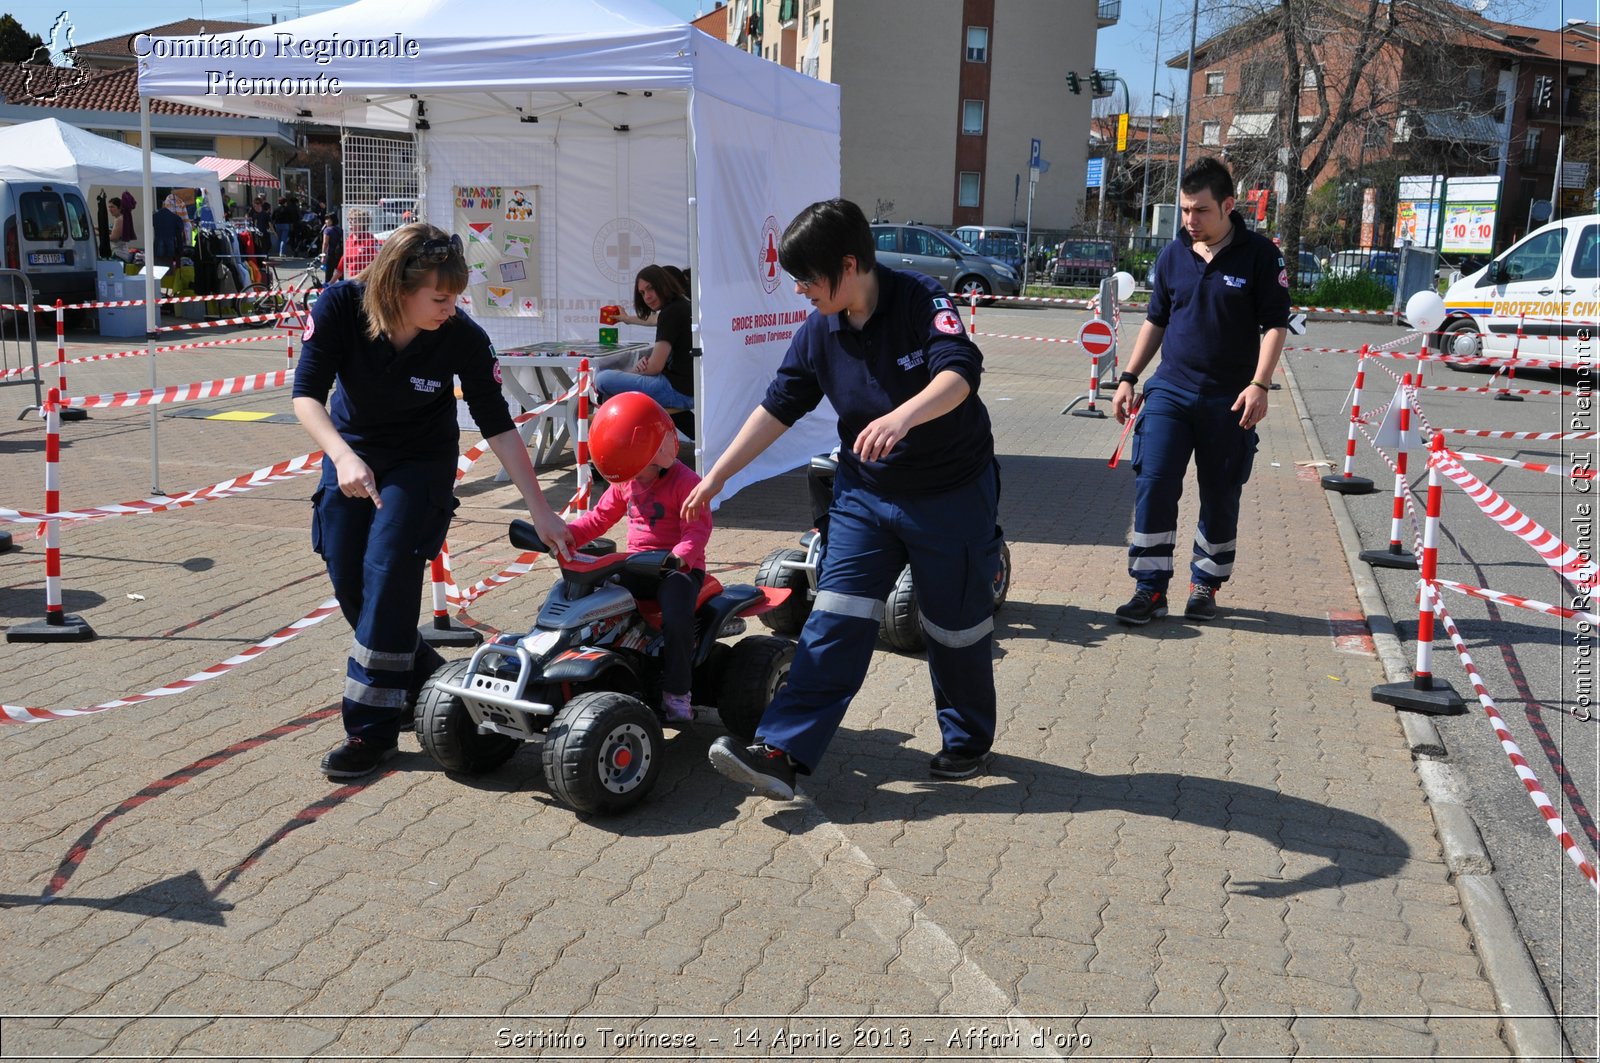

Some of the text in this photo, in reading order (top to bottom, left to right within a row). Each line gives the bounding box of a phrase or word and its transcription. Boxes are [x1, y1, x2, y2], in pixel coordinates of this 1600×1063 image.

[1031, 140, 1040, 165] P
[457, 186, 502, 199] IMPARATE
[455, 198, 475, 209] CON
[1453, 224, 1467, 239] 10
[1478, 224, 1492, 239] 10
[1493, 301, 1571, 316] PROTEZIONE
[732, 310, 807, 331] CROCE ROSSA ITALIANA
[745, 331, 793, 345] Settimo Torinese
